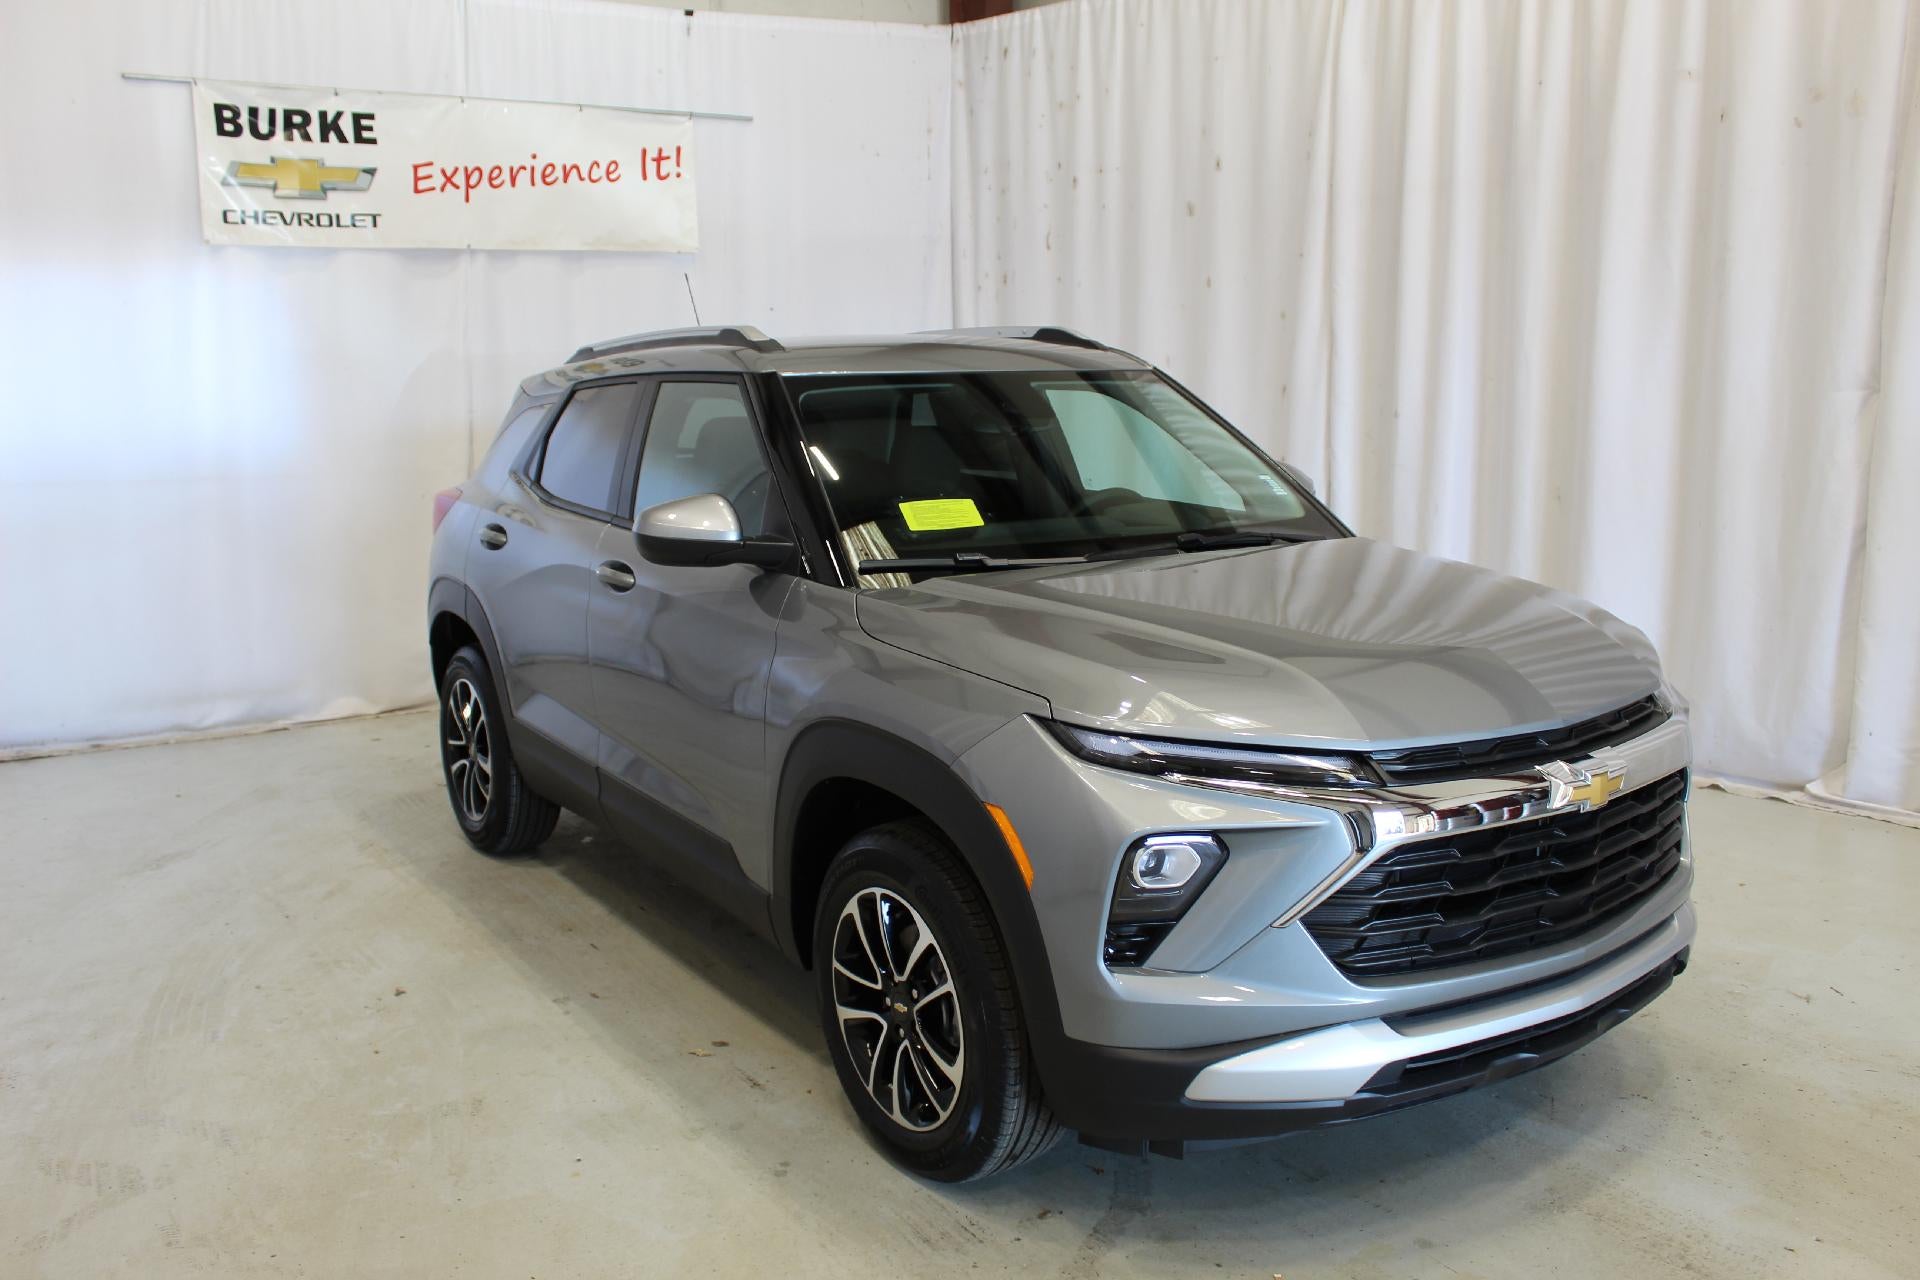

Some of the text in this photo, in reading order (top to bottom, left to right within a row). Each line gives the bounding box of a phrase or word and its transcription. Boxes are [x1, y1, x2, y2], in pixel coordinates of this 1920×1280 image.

[213, 102, 378, 145] BURKE
[411, 145, 682, 204] Experience It!
[222, 208, 382, 228] CHEVROLET
